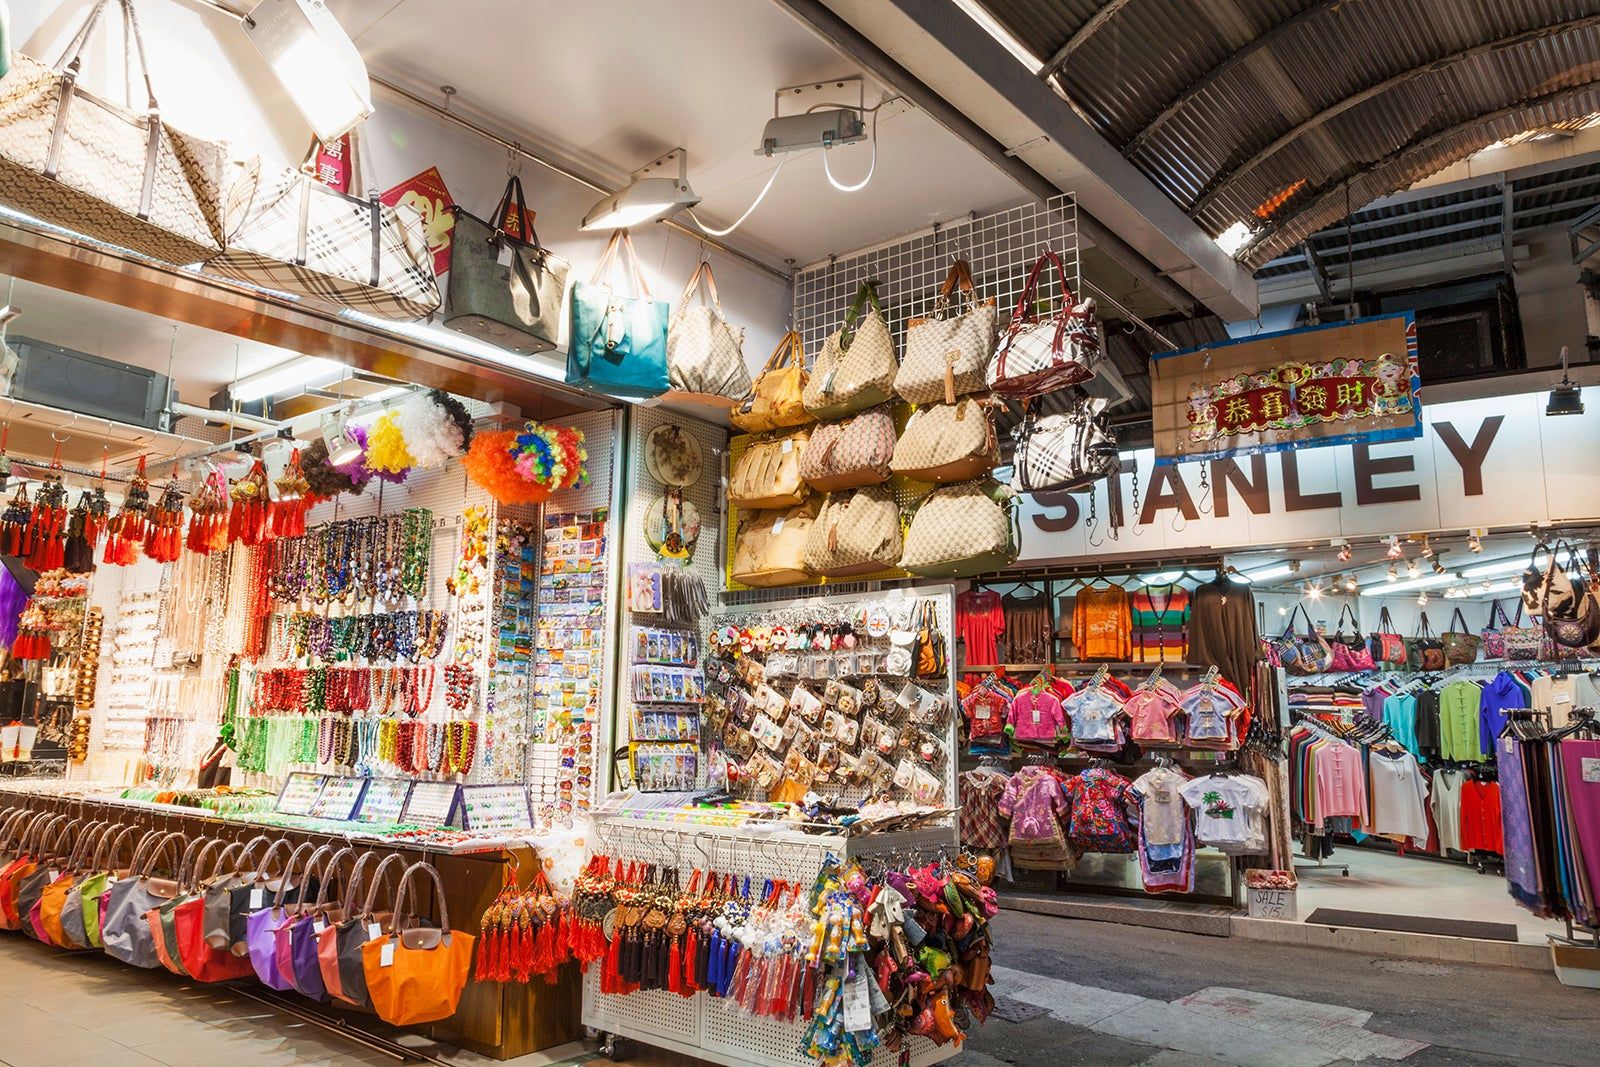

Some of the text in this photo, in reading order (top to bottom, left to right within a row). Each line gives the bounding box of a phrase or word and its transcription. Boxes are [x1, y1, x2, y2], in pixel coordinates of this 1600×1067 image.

[1223, 380, 1366, 424] 恭喜發財
[1031, 415, 1506, 532] STANLEY
[1255, 891, 1285, 906] SALE
